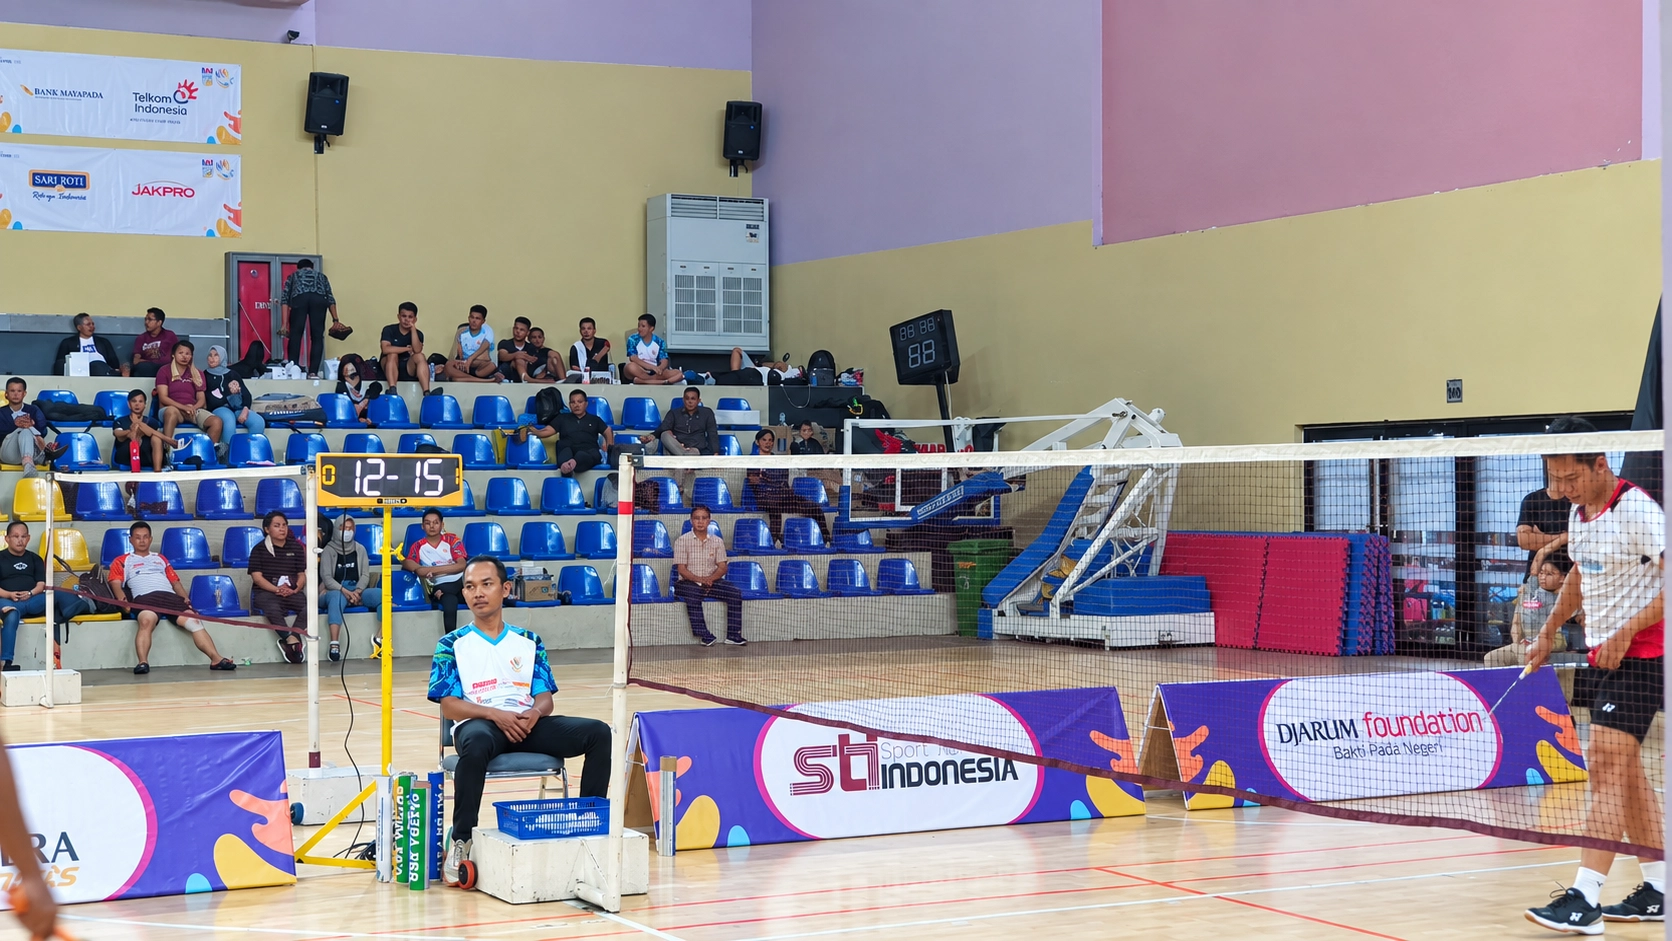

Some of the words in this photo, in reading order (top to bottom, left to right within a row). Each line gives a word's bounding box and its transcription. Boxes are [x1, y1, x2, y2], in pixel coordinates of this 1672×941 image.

[34, 88, 58, 96] BANK
[60, 90, 103, 99] MAYAPADA
[133, 92, 172, 103] Telkom
[135, 104, 187, 115] Indonesia
[35, 175, 57, 185] SARI
[61, 177, 84, 186] ROTI
[132, 184, 195, 198] JAKPRO
[322, 464, 336, 486] 0
[1276, 719, 1359, 747] DJARUM
[1362, 708, 1484, 738] foundation
[880, 742, 928, 762] Sport
[1333, 744, 1366, 760] Bakti
[1369, 741, 1401, 757] Pada
[1403, 741, 1443, 757] Negeri
[881, 757, 1019, 790] INDONESIA
